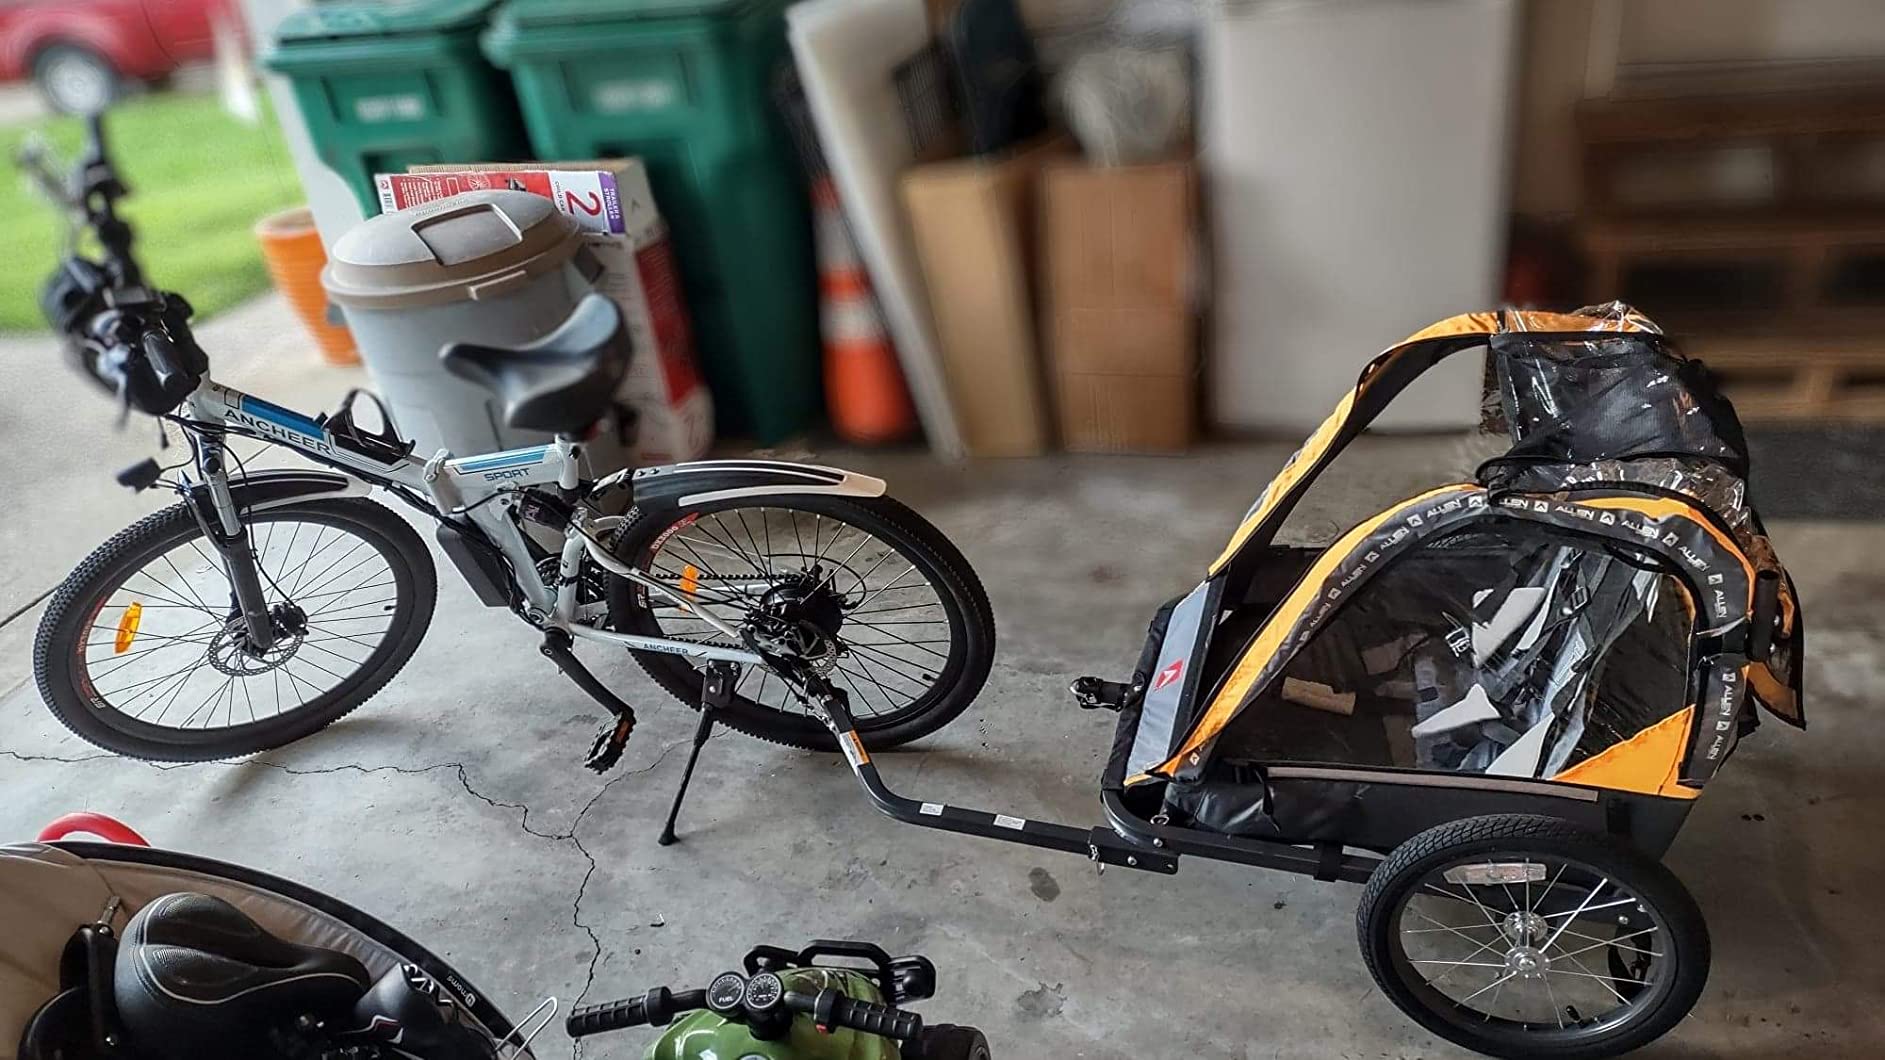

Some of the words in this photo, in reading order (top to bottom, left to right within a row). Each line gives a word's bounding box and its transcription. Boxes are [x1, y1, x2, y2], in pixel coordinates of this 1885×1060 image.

[565, 191, 602, 217] 2
[603, 188, 614, 219] STROLLER
[609, 188, 619, 214] TRAILER
[224, 408, 332, 456] ANCHEER
[483, 467, 530, 482] SPORT
[1426, 498, 1462, 518] ALLEN
[1554, 505, 1595, 521] ALLEN
[1379, 525, 1410, 551] ALLEN
[1620, 519, 1660, 539] ALLEN
[1678, 545, 1711, 572] ALLEN
[1340, 563, 1367, 588] ALLEN
[1309, 602, 1331, 628] ALLEN
[1714, 588, 1728, 619] ALLEN
[643, 642, 689, 655] ANCHEER
[1719, 684, 1734, 716] ALLEN
[1706, 734, 1724, 761] ALLEN
